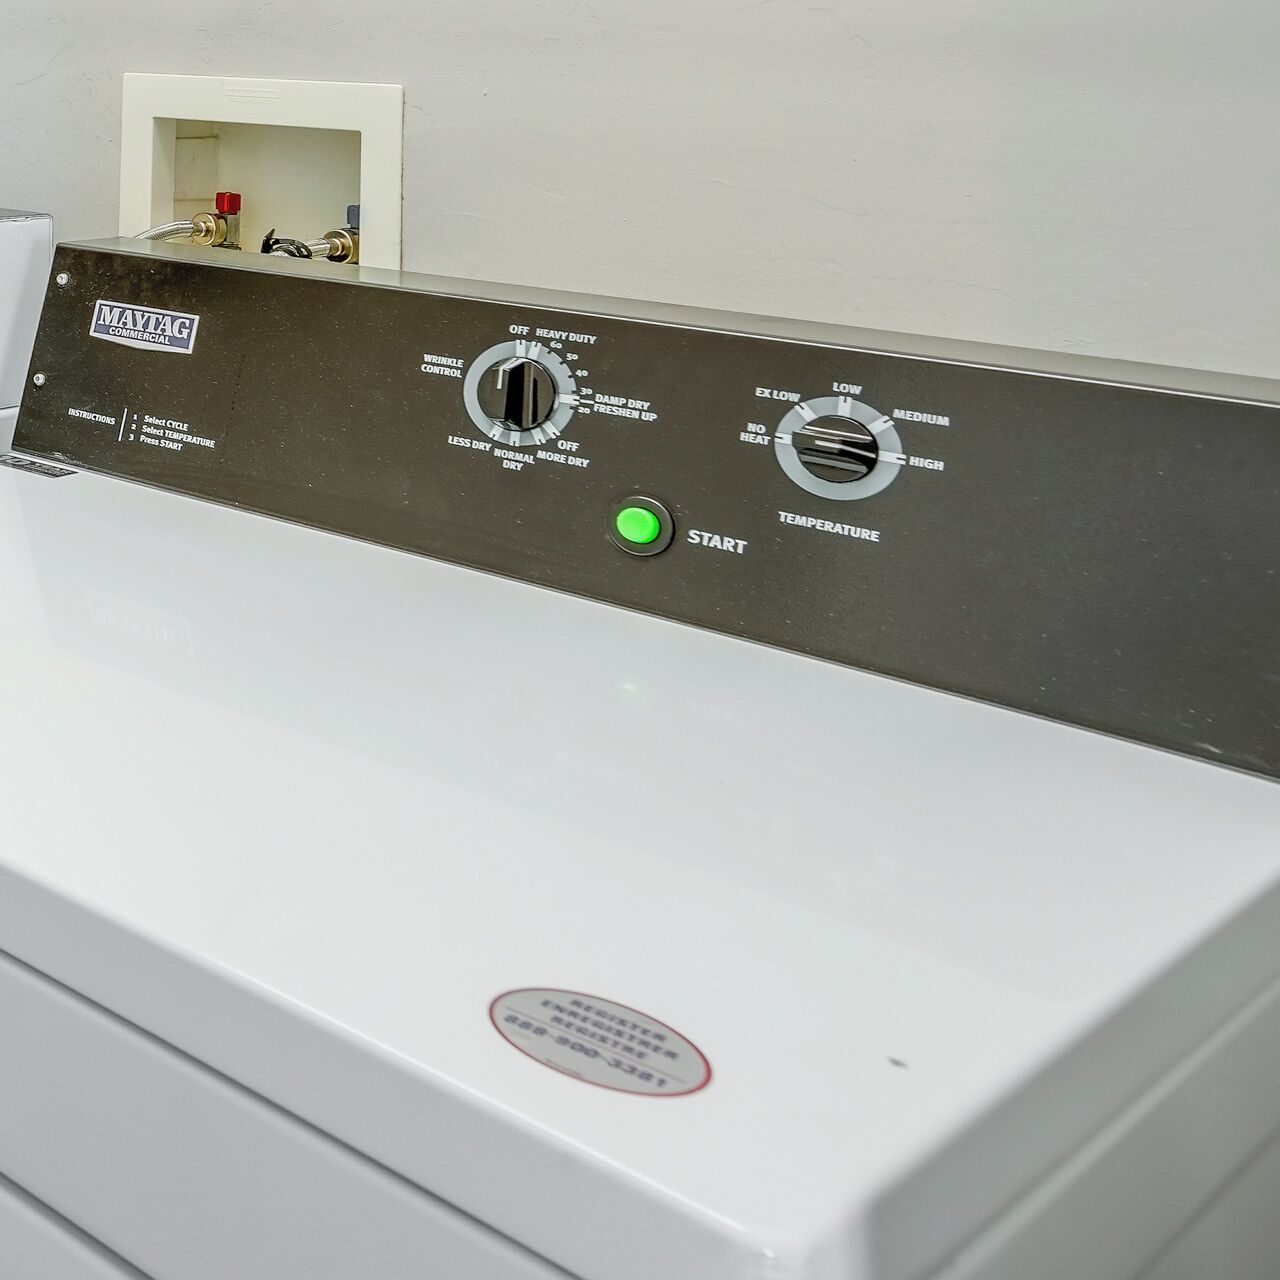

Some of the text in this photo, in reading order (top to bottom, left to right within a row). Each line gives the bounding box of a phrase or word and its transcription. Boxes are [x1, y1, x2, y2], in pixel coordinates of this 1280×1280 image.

[97, 305, 190, 339] MAYTAG
[509, 324, 530, 336] OFF
[109, 326, 171, 345] COMMERCIAL
[535, 327, 597, 345] HEAVY DUTY
[550, 341, 563, 349] 60
[423, 353, 464, 368] WRINKLE
[566, 353, 579, 361] 50
[420, 364, 463, 378] CONTROL
[575, 369, 589, 377] 40
[580, 387, 592, 395] 30
[755, 387, 802, 403] EX LOW
[832, 382, 863, 396] LOW
[578, 406, 590, 414] 20
[595, 394, 651, 410] DAMP DRY
[68, 407, 116, 425] INSTRUCTIONS
[593, 404, 658, 422] FRESHEN UP
[892, 409, 951, 427] MEDIUM
[144, 415, 166, 427] Select
[166, 419, 189, 432] CYCLE
[747, 422, 766, 434] NO
[128, 433, 183, 451] 3 Press START
[142, 425, 164, 437] Select
[164, 429, 215, 449] TEMPERATURE
[448, 435, 492, 452] LESS DRY
[740, 432, 771, 446] HEAT
[557, 440, 579, 452] OFF
[493, 448, 535, 464] NORMAL
[536, 450, 590, 468] MORE DRY
[909, 456, 945, 471] HIGH
[502, 459, 523, 471] DRY
[778, 511, 881, 543] TEMPERATURE
[687, 529, 748, 554] START
[569, 998, 667, 1043] REGISTER
[540, 998, 679, 1061] ENREGISTRER
[549, 1014, 648, 1060] REGISTRE
